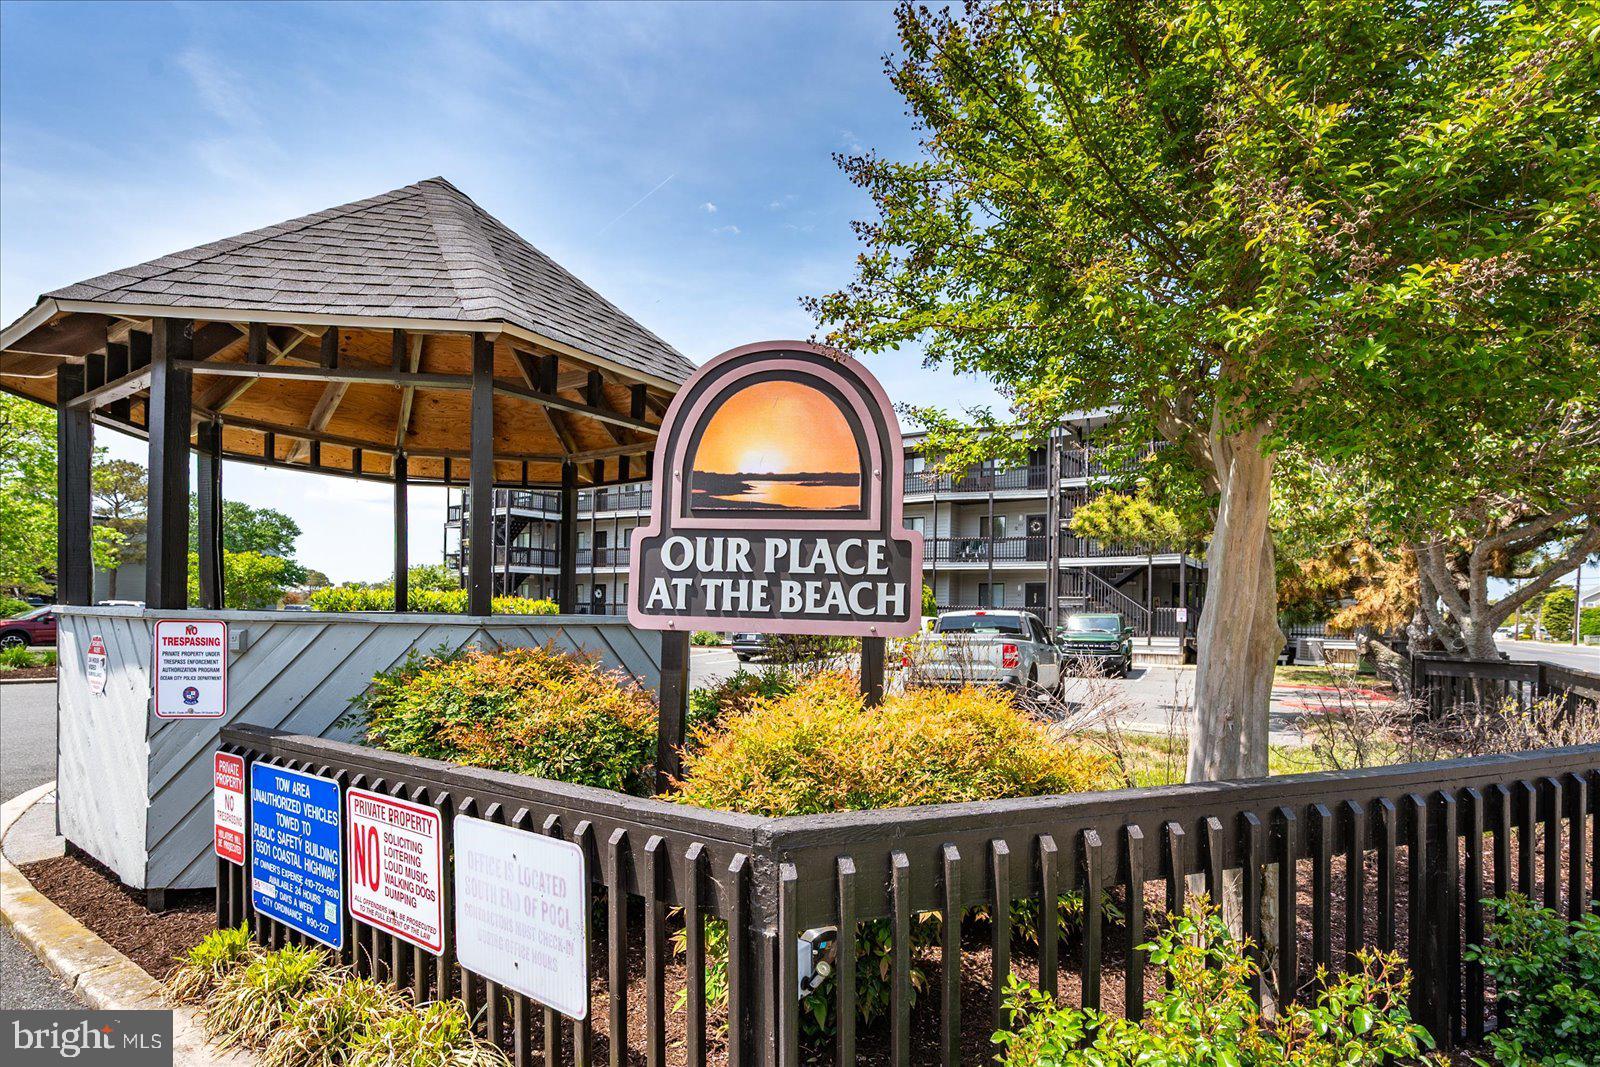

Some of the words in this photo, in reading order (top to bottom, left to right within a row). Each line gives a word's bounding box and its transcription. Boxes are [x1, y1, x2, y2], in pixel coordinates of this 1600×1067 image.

[661, 536, 752, 573] OUR
[764, 538, 889, 576] PLACE
[645, 577, 693, 610] AT
[701, 579, 771, 612] THE
[780, 580, 905, 616] BEACH
[162, 637, 220, 646] TRESPASSING
[186, 626, 197, 635] NO
[216, 772, 242, 790] PROPERTY
[219, 760, 239, 776] PRIVATE
[225, 794, 234, 811] NO
[275, 777, 289, 792] TOW
[292, 782, 310, 799] AREA
[217, 810, 242, 827] TRESPASSING
[253, 787, 301, 812] UNAUTHORIZED
[303, 803, 338, 826] VEHICLES
[354, 798, 385, 821] PRIVATE
[388, 807, 432, 835] PROPERTY
[276, 812, 300, 831] TOWED
[301, 820, 311, 836] TO
[254, 822, 275, 841] PUBLIC
[277, 832, 302, 849] SAFETY
[305, 841, 338, 865] BUILDING
[354, 822, 380, 892] NO
[384, 832, 423, 854] SOLICITING
[384, 846, 421, 867] LOITERING
[256, 839, 270, 857] 6501
[272, 847, 302, 869] COASTAL
[304, 859, 336, 881] HIGHWAY
[384, 859, 403, 875] LOUD
[405, 866, 428, 884] MUSIC
[467, 850, 502, 878] OFFICE
[504, 861, 515, 881] IS
[518, 866, 566, 898] LOCATED
[254, 857, 259, 867] AT
[260, 860, 280, 875] OWNER'S
[304, 877, 339, 900] 410-723-6610
[268, 876, 294, 892] AVAILABLE
[294, 885, 302, 896] 24
[302, 888, 321, 905] HOURS
[384, 872, 414, 893] WALKING
[416, 883, 435, 902] DOGS
[279, 892, 292, 906] DAYS
[293, 898, 298, 907] A
[298, 900, 314, 915] WEEK
[384, 886, 417, 908] DUMPING
[465, 877, 497, 907] SOUTH
[500, 888, 520, 912] END
[524, 895, 539, 918] OF
[541, 900, 572, 931] POOL
[262, 896, 273, 909] CITY
[274, 901, 302, 923] ORDINANCE
[307, 917, 329, 934] #90-227
[363, 897, 387, 914] OFFENDERS
[388, 908, 398, 919] WL
[399, 913, 405, 921] BE
[406, 915, 437, 935] PROSECUTED
[366, 907, 374, 916] THE
[375, 911, 385, 922] FULL
[386, 915, 403, 929] EXTENT
[410, 926, 419, 936] THE
[420, 930, 431, 941] LAW
[515, 920, 535, 941] MUST
[538, 928, 574, 957] CHECK-IN
[505, 939, 530, 961] OFFICE
[531, 950, 558, 973] HOURS
